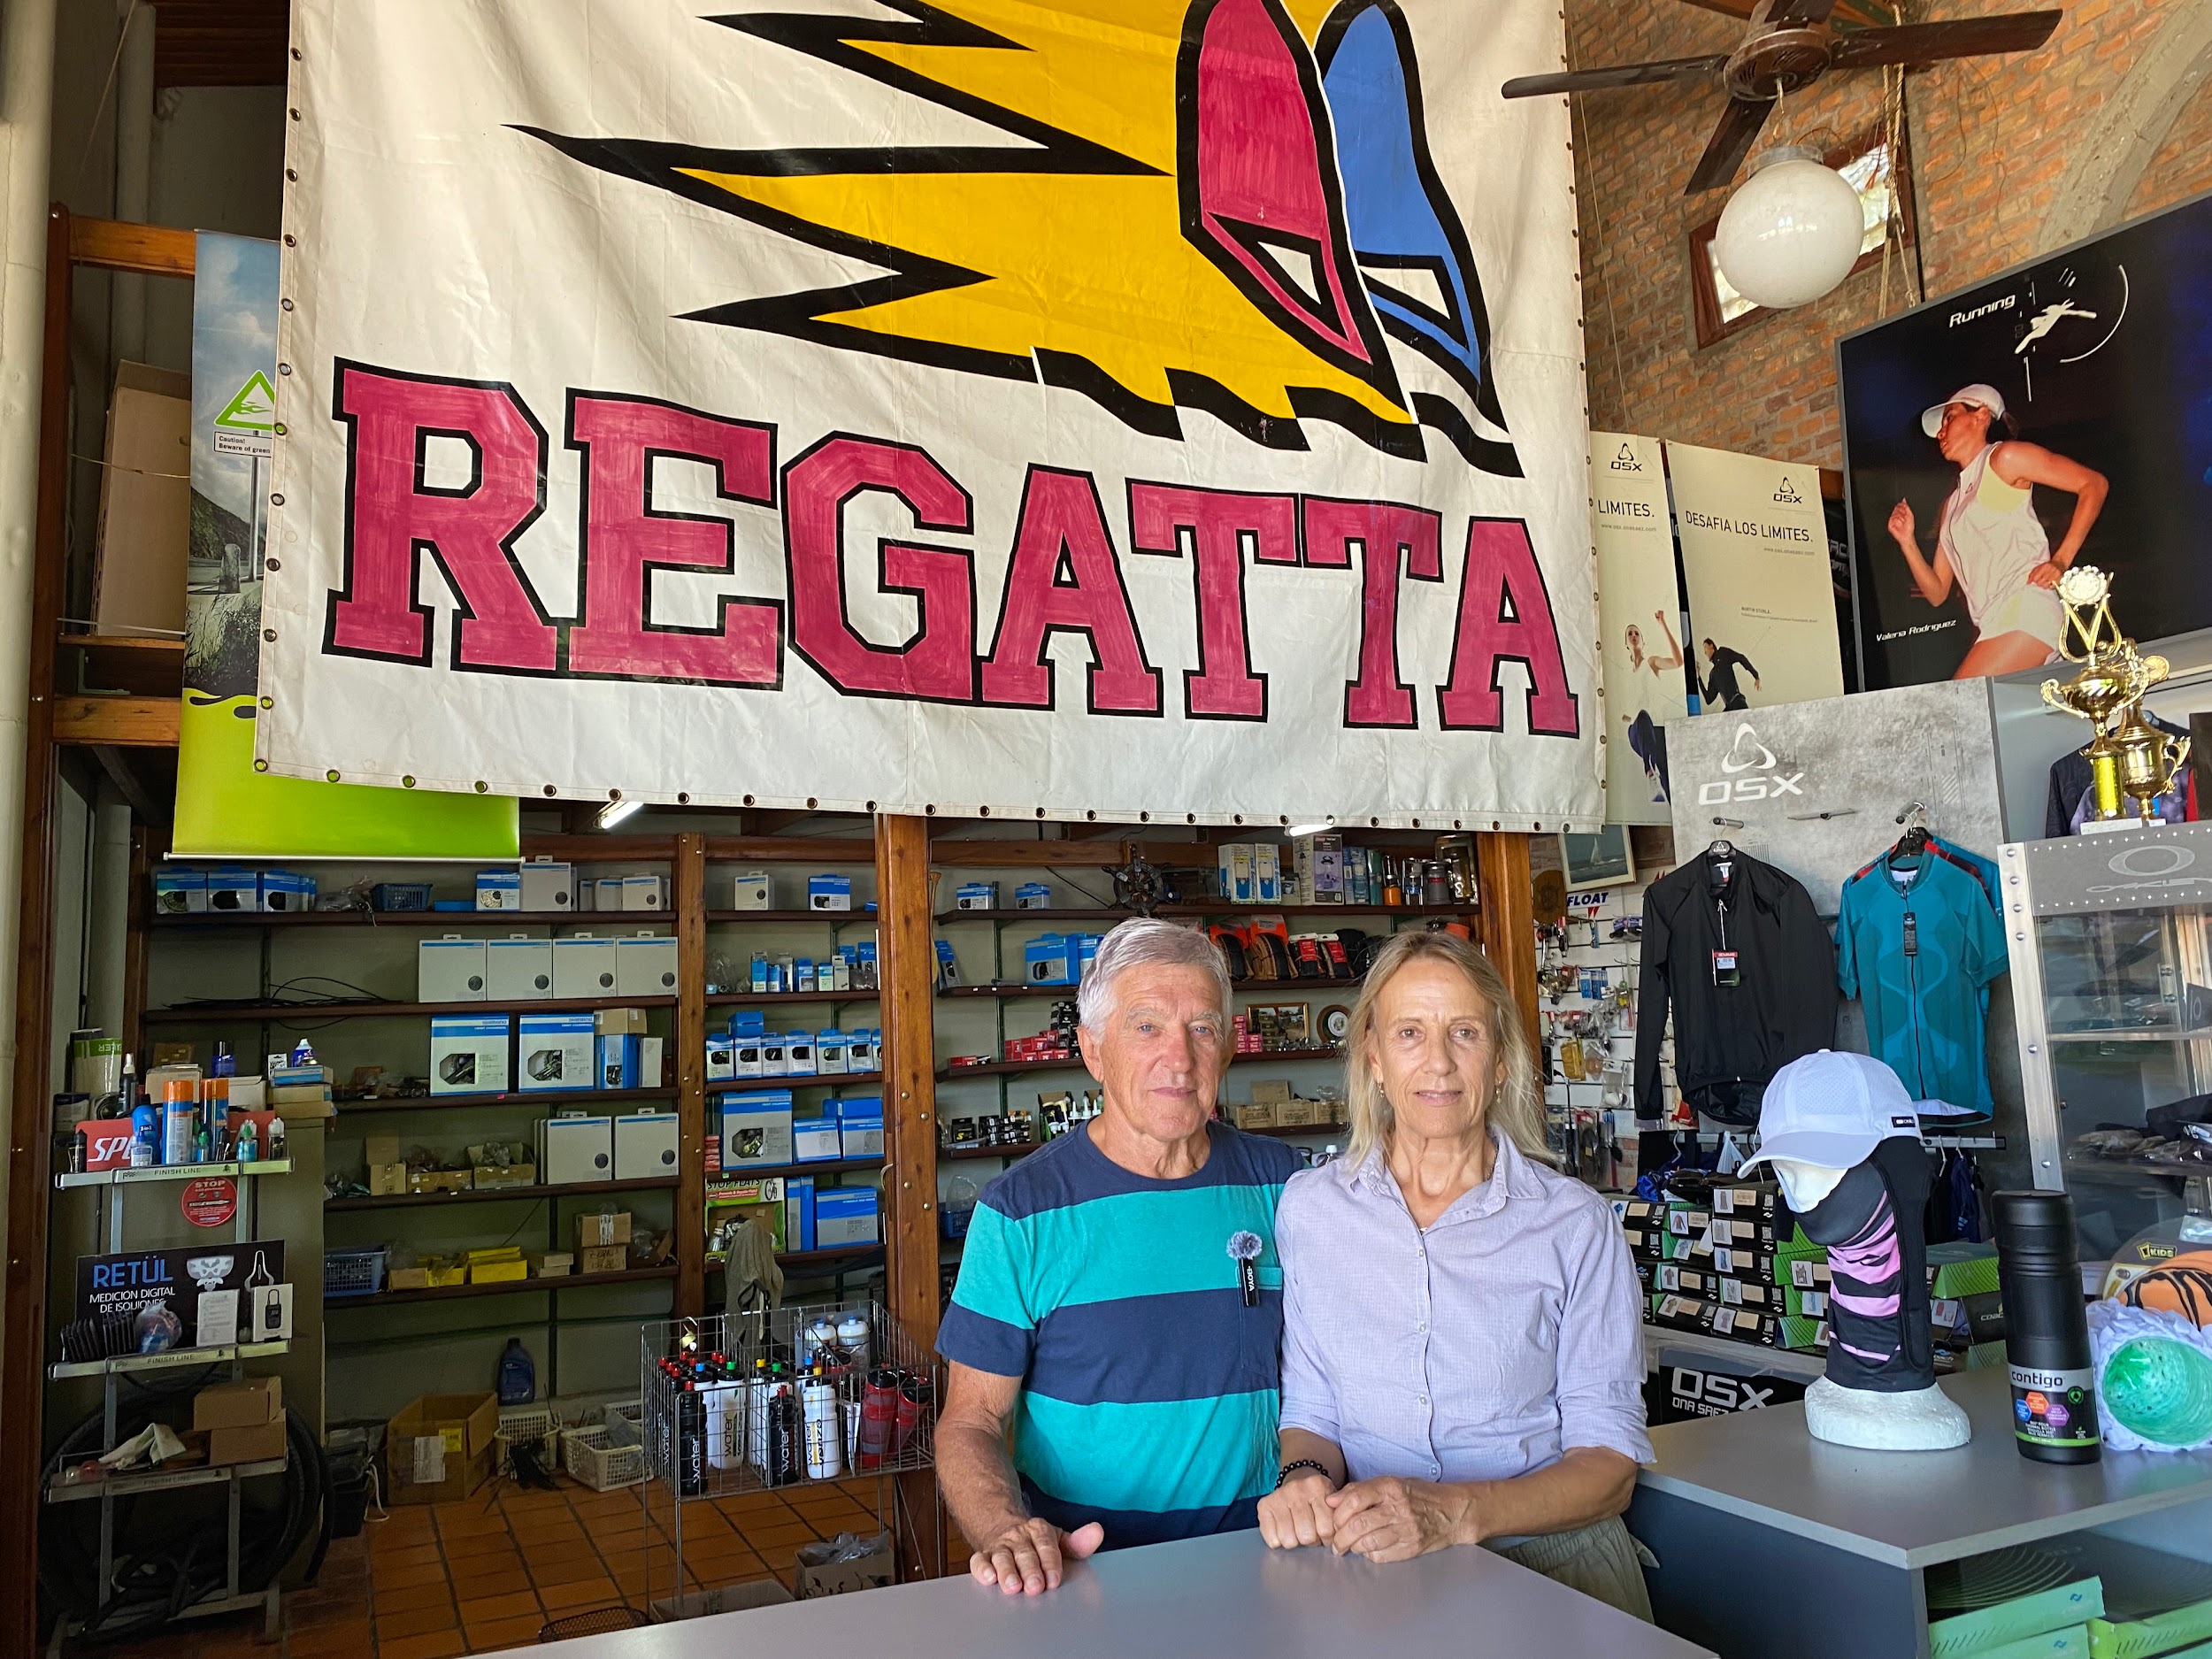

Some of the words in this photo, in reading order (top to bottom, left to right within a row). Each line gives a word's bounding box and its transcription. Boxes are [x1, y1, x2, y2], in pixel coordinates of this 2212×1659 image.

[1949, 295, 2016, 327] Running
[1610, 461, 1642, 472] OSX
[1773, 493, 1802, 503] OSX
[1598, 499, 1655, 518] LIMITES.
[1686, 511, 1732, 533] DESAFIA
[1735, 520, 1758, 535] LOS
[1761, 524, 1814, 542] LIMITES.
[321, 356, 1579, 739] REGATTA
[1909, 619, 1956, 634] Rodriguez
[1698, 772, 1805, 806] OSX
[1566, 892, 1609, 907] FLOAT
[195, 1179, 226, 1188] STOP
[2150, 1248, 2174, 1257] KIDS
[141, 1286, 176, 1298] DIGITAL
[100, 1303, 113, 1314] DE
[147, 1356, 175, 1364] FINISH
[2011, 1371, 2063, 1388] contigo
[1671, 1366, 1774, 1411] OSX
[780, 1430, 789, 1473] water
